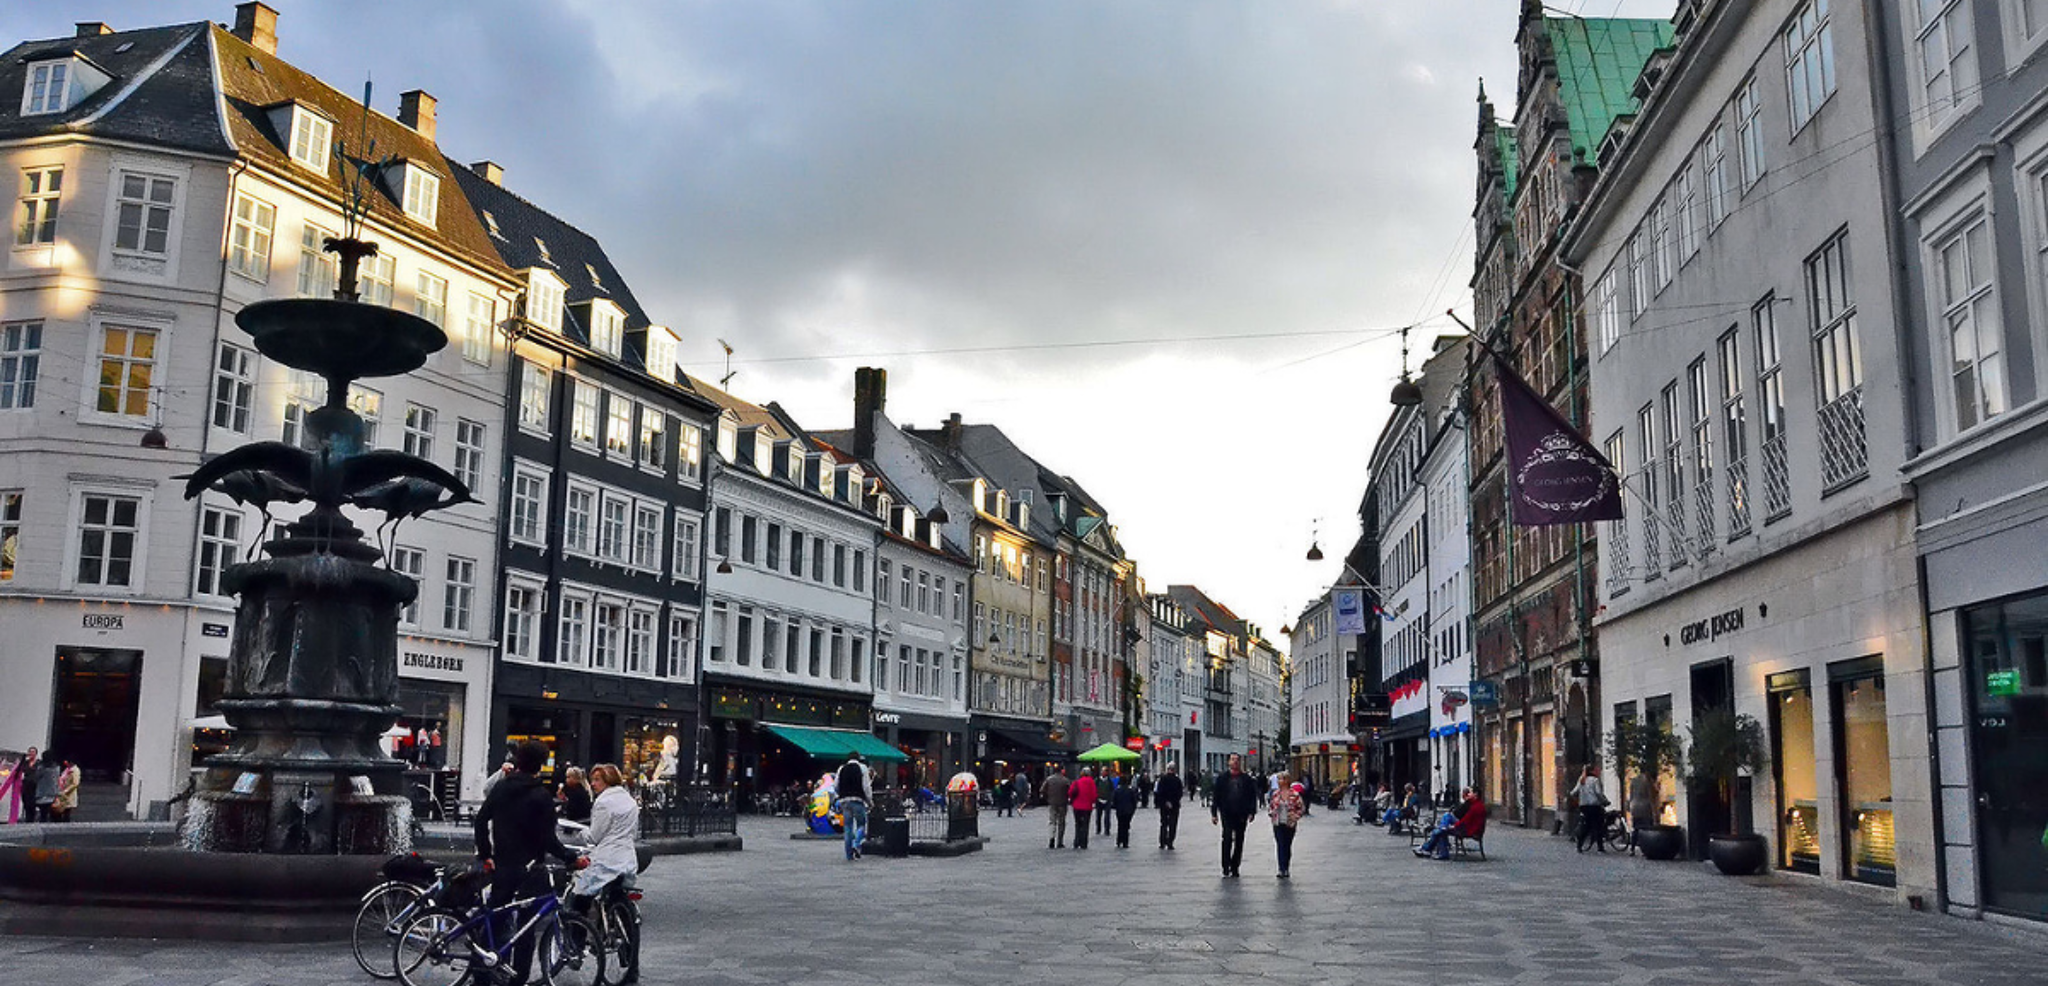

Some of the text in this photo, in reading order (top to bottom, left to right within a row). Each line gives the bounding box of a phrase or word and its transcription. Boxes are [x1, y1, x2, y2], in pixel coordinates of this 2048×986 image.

[82, 614, 124, 629] EUROPA
[1680, 607, 1744, 646] GEORG JENSEN
